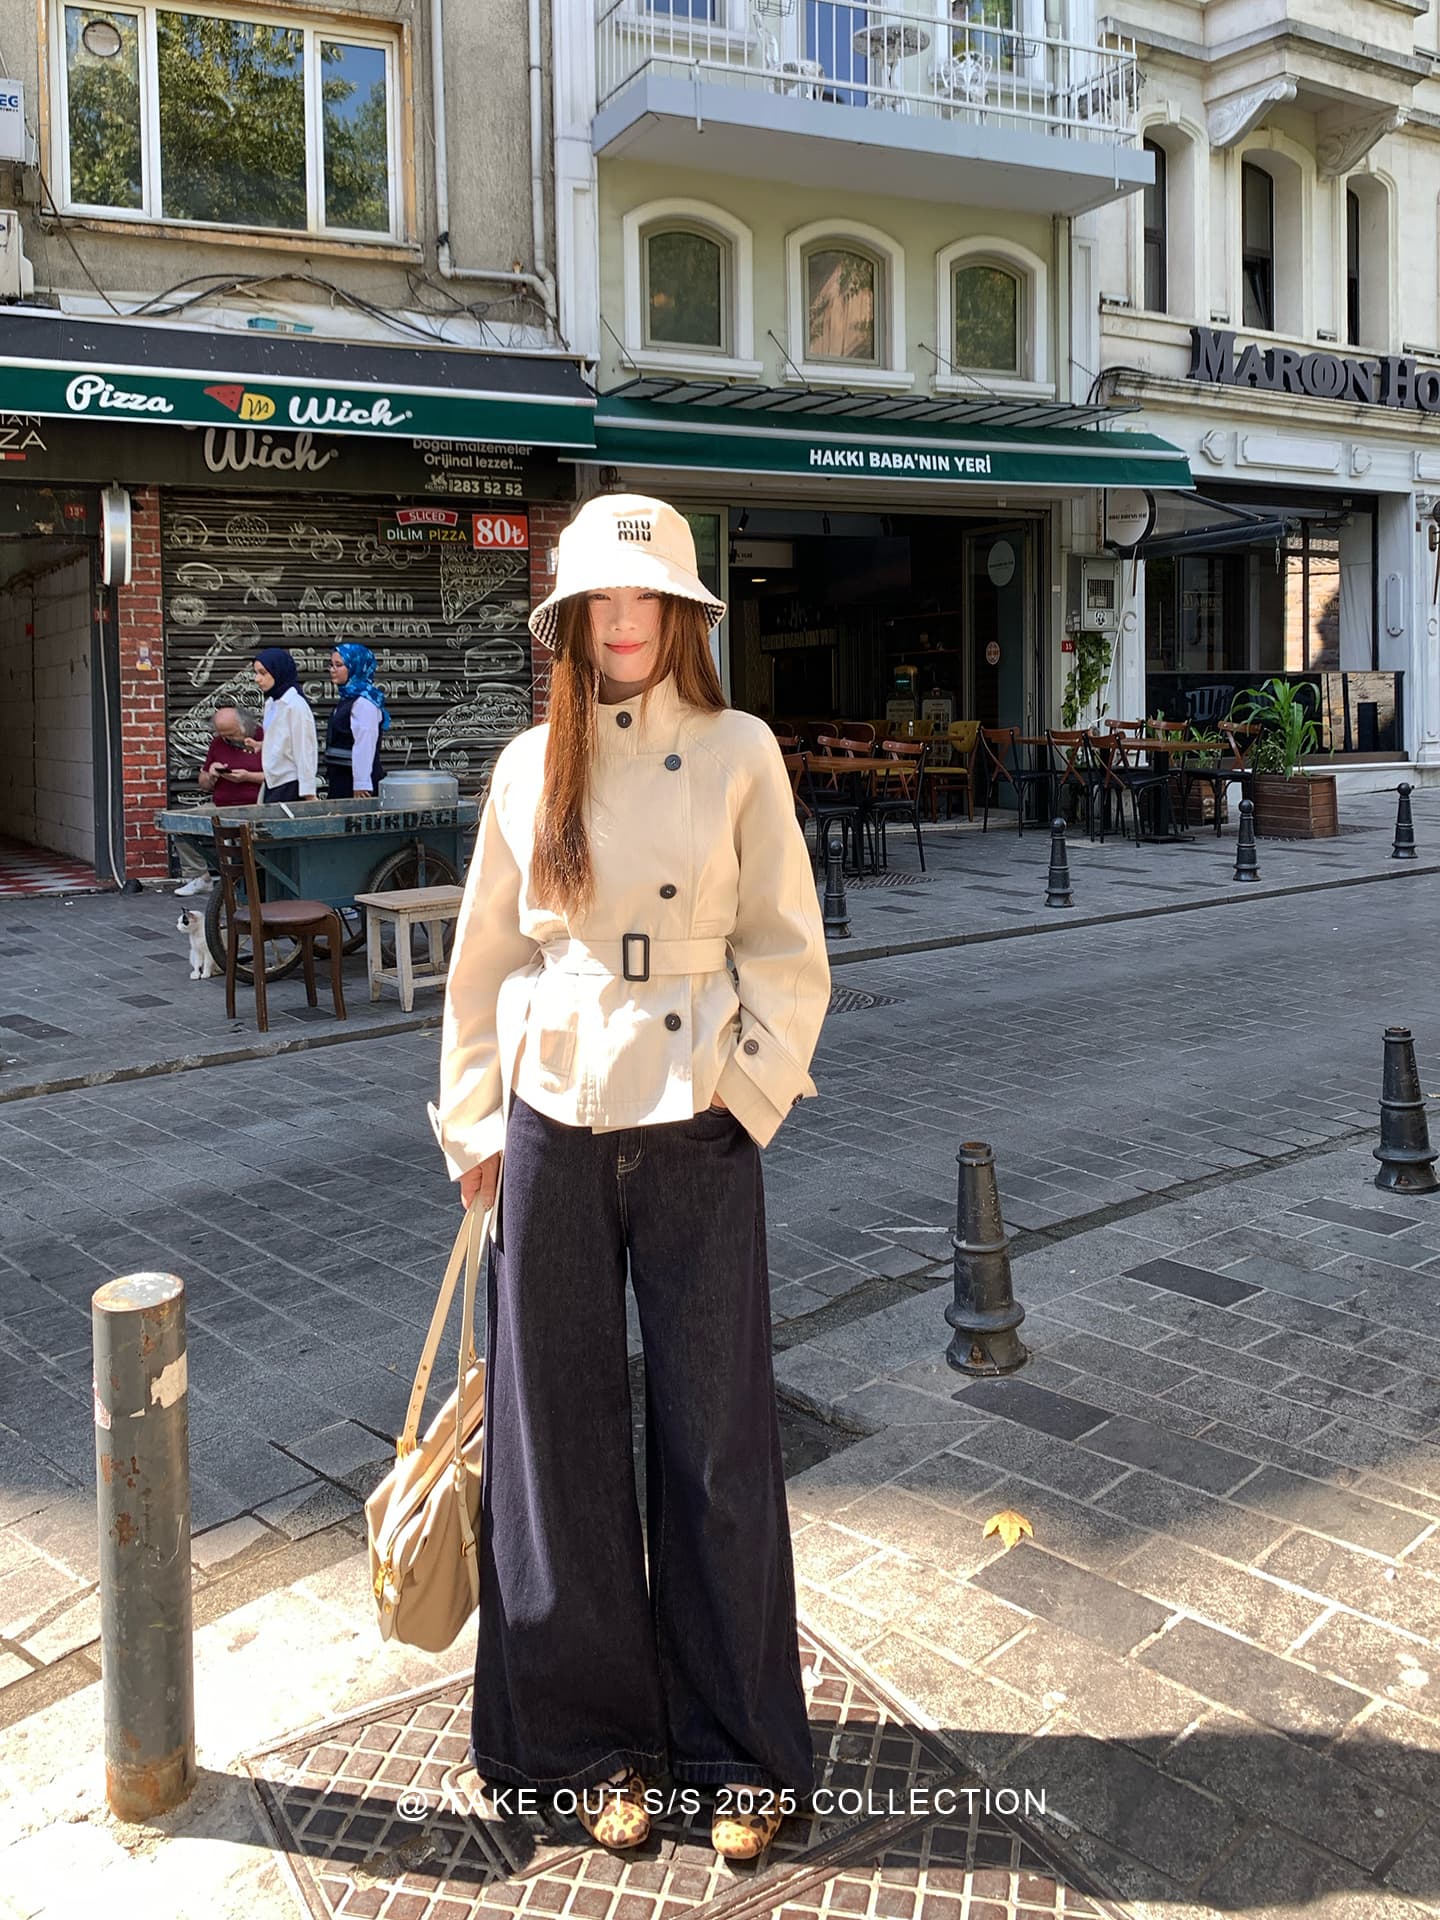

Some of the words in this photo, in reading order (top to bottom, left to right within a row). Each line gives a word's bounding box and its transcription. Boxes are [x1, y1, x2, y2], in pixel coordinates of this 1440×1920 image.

[1187, 327, 1379, 404] MAROON
[66, 374, 174, 413] Pizza
[289, 396, 406, 427] Wich
[204, 427, 330, 472] Wich
[424, 453, 473, 469] Orijinal
[809, 449, 865, 467] HAKKI
[869, 452, 950, 472] BABA'NIN
[954, 454, 992, 473] YERİ
[484, 481, 501, 495] 52
[505, 483, 523, 497] 52
[408, 511, 446, 522] SLICED
[617, 519, 651, 530] miu
[386, 528, 423, 541] DİLİM
[618, 529, 652, 542] miu
[281, 612, 433, 642] Biliyorum
